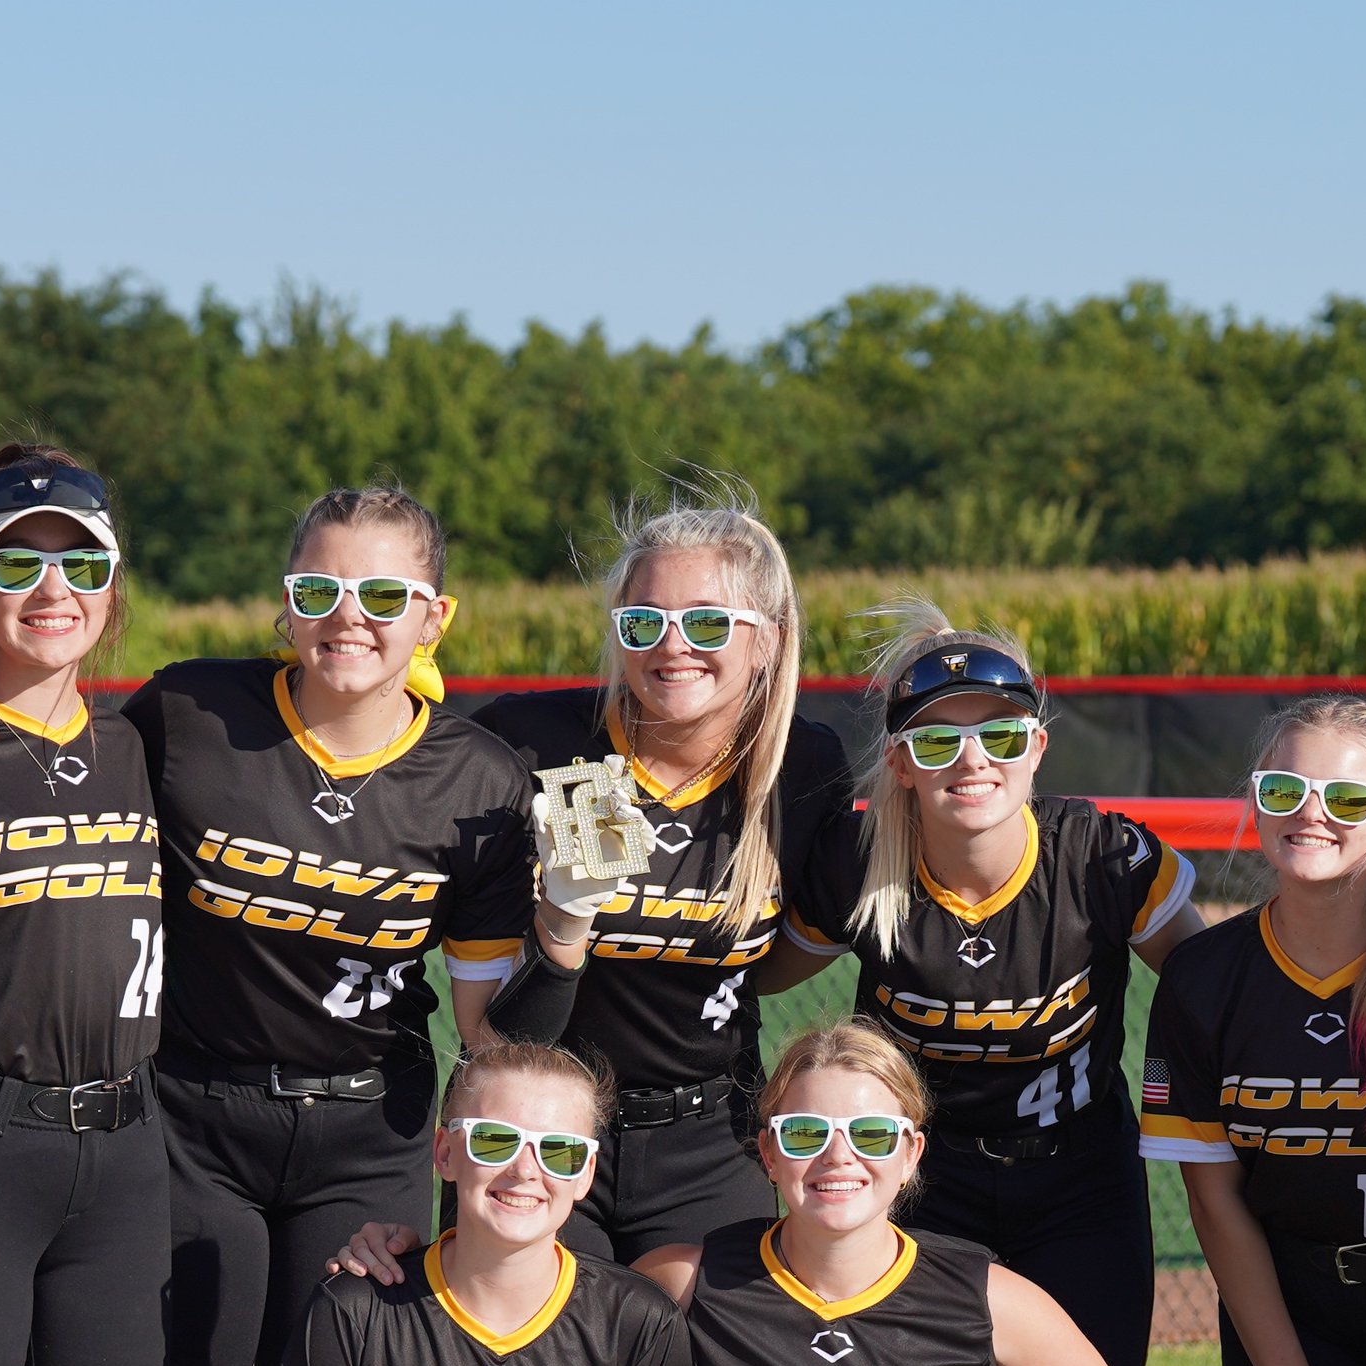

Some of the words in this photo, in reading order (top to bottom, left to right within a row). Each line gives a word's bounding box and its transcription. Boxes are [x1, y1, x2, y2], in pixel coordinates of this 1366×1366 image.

[196, 828, 450, 903] IOWA
[187, 878, 432, 950] GOLD
[586, 928, 778, 967] OLD
[875, 965, 1091, 1031] IOWA
[1017, 1040, 1092, 1128] 41
